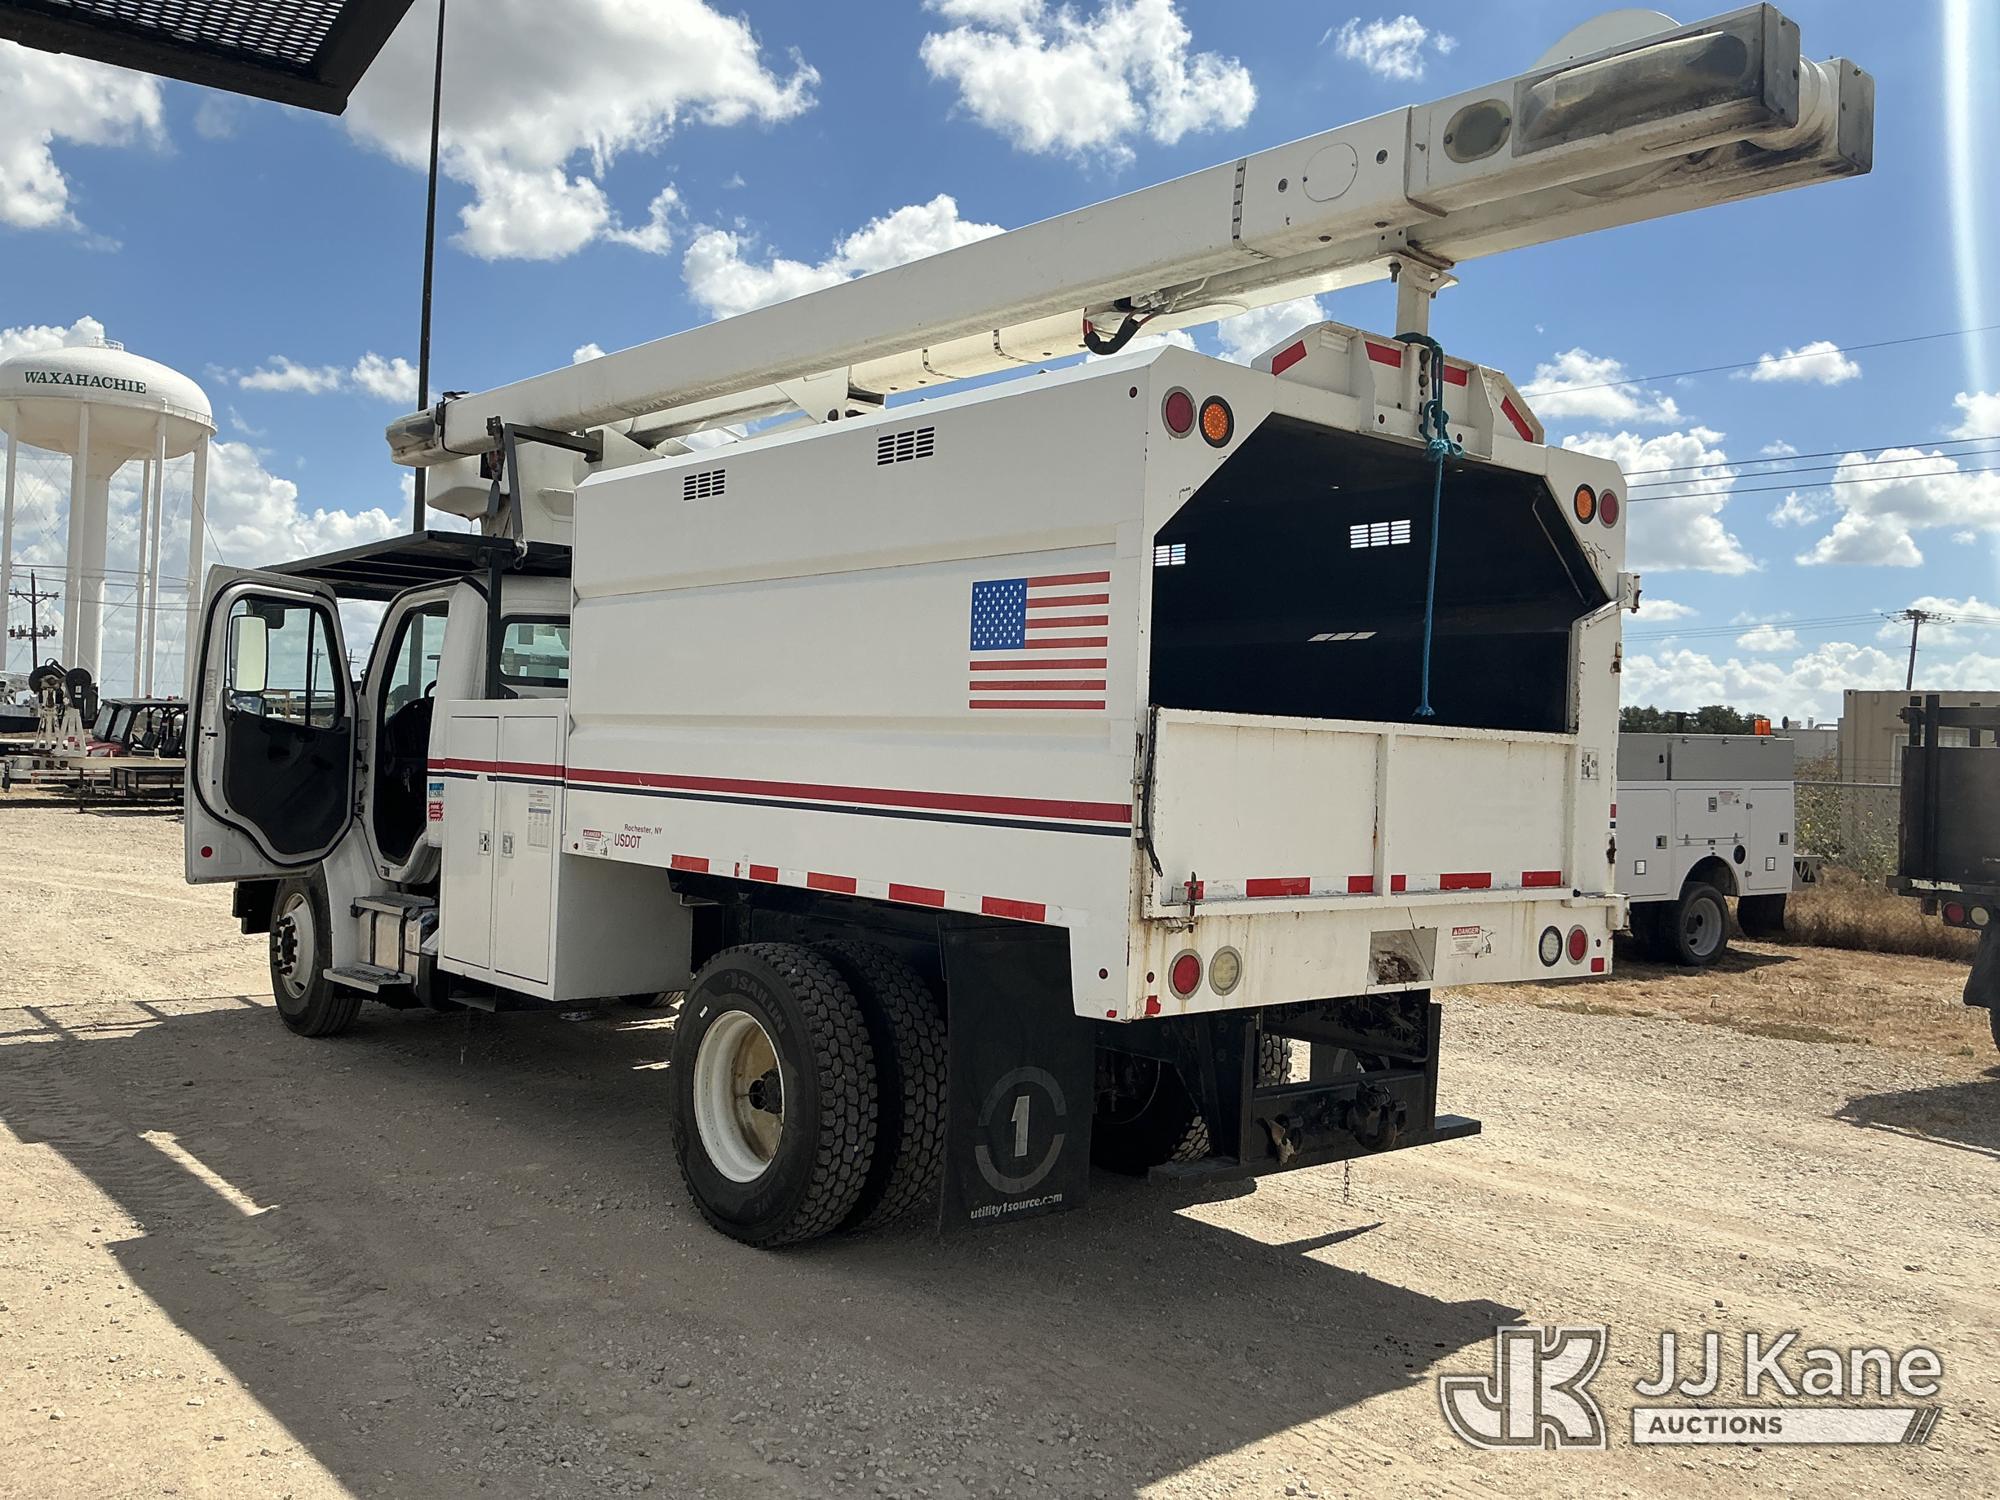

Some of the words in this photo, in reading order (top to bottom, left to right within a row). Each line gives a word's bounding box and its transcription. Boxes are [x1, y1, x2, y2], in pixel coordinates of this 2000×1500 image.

[24, 371, 147, 394] WAXAHACHIE
[624, 823, 653, 834] Rochester,
[654, 826, 663, 835] NY
[614, 833, 642, 849] USDOT
[1457, 926, 1479, 935] DANGER
[1010, 1095, 1030, 1158] 1
[970, 1193, 1063, 1219] utility1source.com
